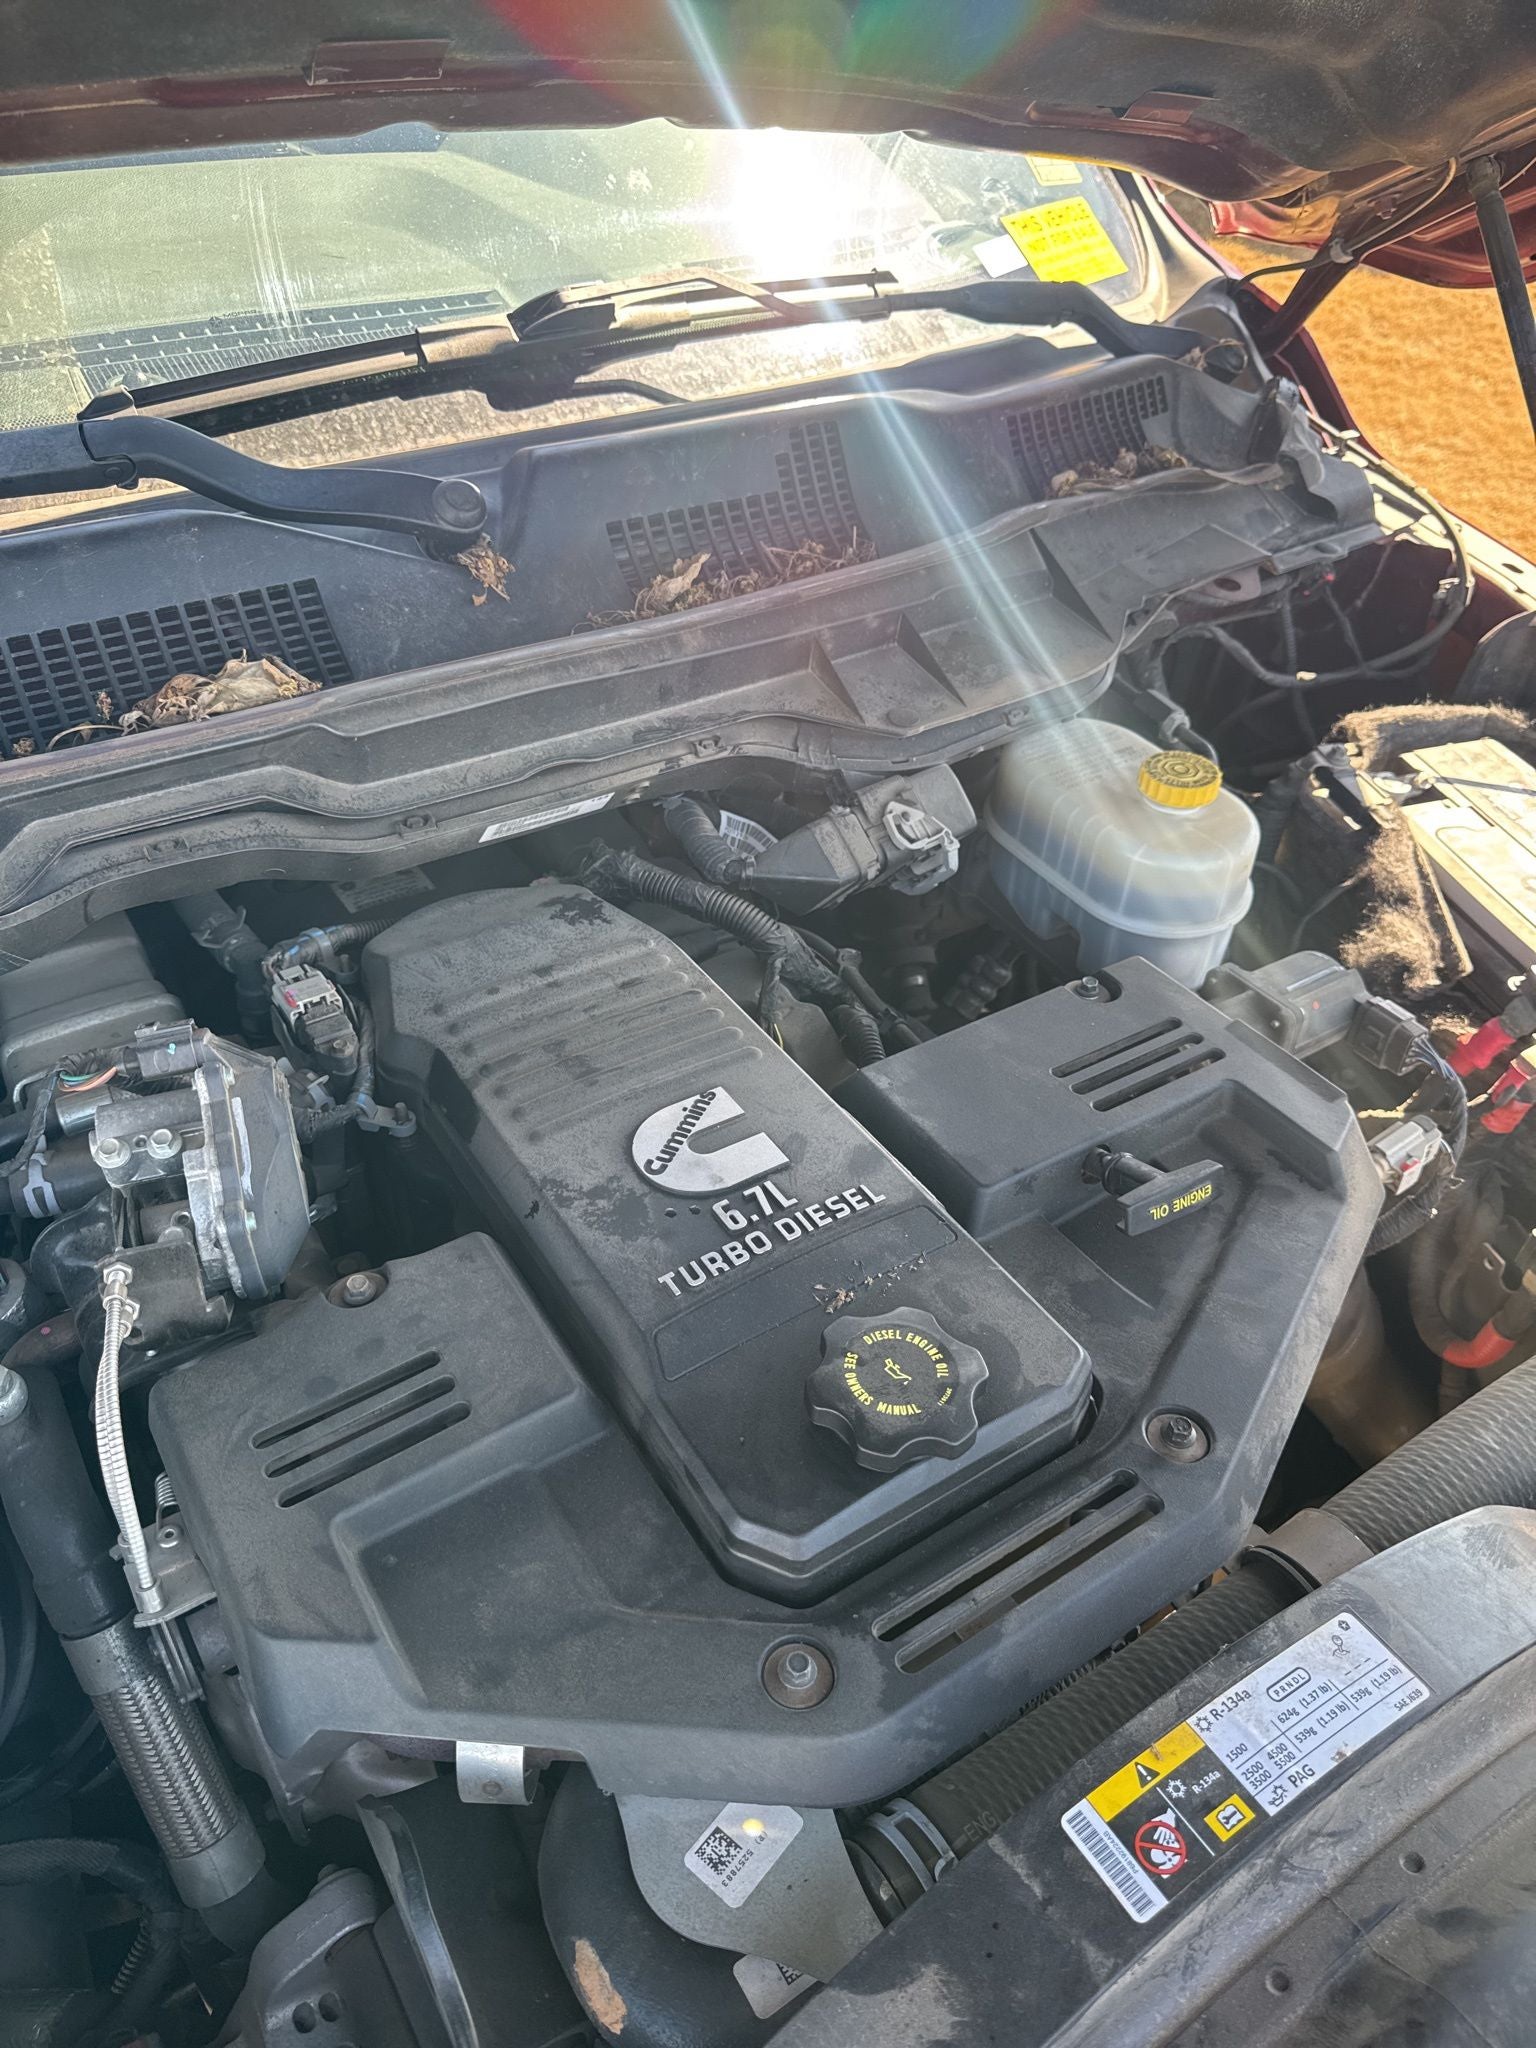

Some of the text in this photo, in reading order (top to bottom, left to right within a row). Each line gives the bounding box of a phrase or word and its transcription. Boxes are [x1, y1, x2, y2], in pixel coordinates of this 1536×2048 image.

[643, 1090, 717, 1176] Cummins
[712, 1180, 799, 1231] 6.7L
[1150, 1184, 1212, 1220] ENGINE OIL
[657, 1184, 887, 1297] TURBO DIESEL
[862, 1329, 949, 1378] DIESEL ENGINE OIL
[844, 1351, 922, 1416] SEE OWNERS MANUAL
[1277, 1681, 1332, 1724] 624g (1.37 lb)
[1350, 1664, 1403, 1703] 539g (1.19 lb)
[1210, 1688, 1252, 1721] R-134a
[1294, 1700, 1351, 1744] 539g (1.19 lb)
[1394, 1698, 1409, 1711] SAE
[1225, 1742, 1249, 1763] 1500
[1241, 1742, 1288, 1781] 2500 4500
[1249, 1751, 1296, 1790] 3500 5500
[1190, 1769, 1222, 1794] R-134a
[1287, 1763, 1316, 1788] PAG
[721, 1849, 754, 1888] 5257883
